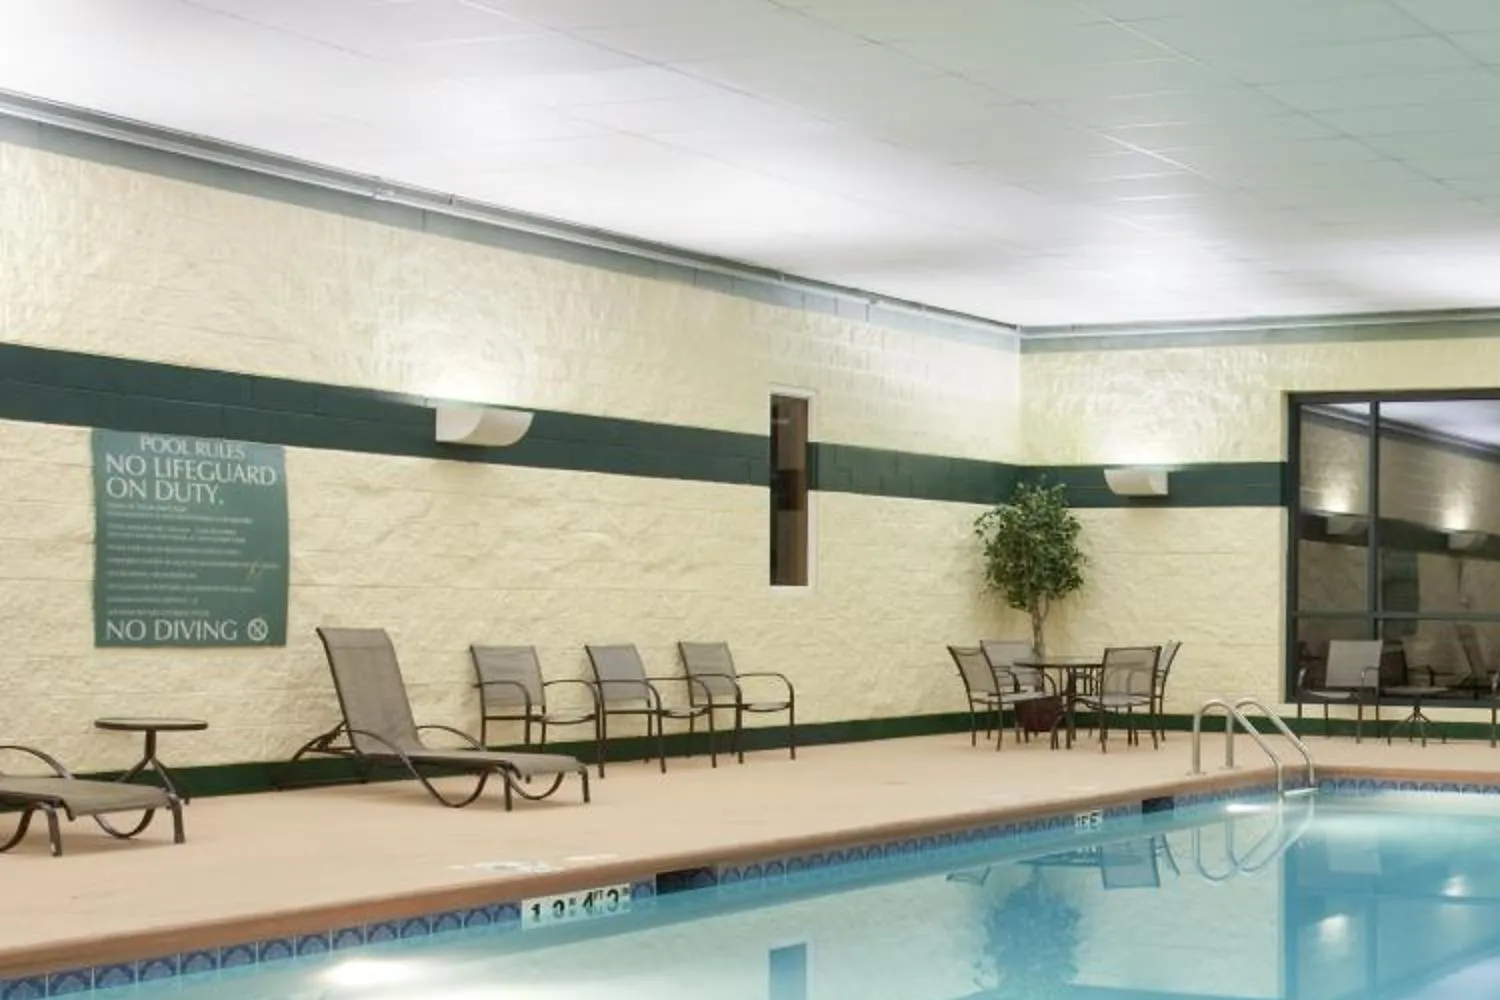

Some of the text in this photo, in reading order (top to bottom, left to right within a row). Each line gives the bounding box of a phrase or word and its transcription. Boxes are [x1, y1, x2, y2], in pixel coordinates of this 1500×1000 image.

[140, 436, 246, 460] POOL RULES
[105, 453, 276, 486] NO LIFEGUARD
[105, 476, 224, 505] ON DUTY.
[105, 619, 237, 641] NO DIVING
